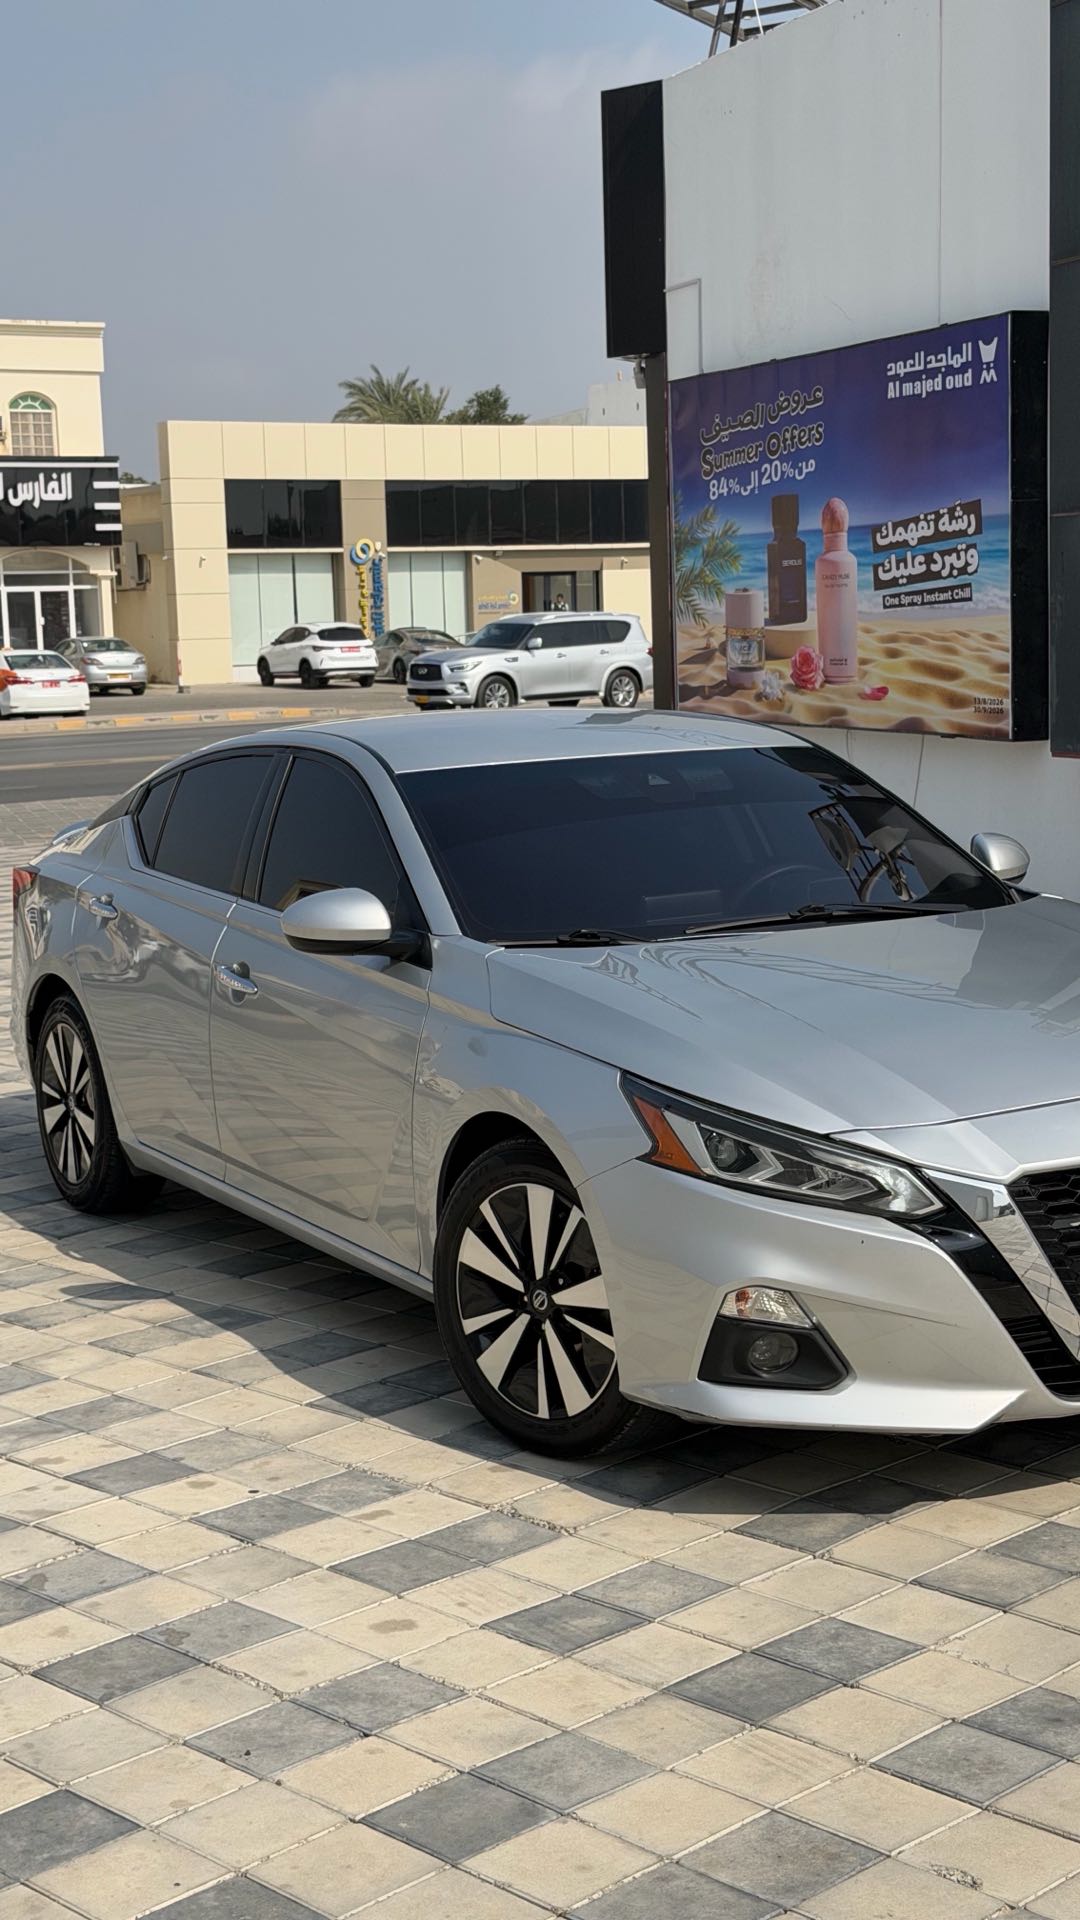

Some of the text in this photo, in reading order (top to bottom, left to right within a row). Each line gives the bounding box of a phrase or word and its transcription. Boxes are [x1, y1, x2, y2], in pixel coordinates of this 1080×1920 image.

[887, 341, 972, 377] الماجد للعود
[887, 368, 972, 399] Al majed oud
[700, 386, 824, 446] عروض الصيف
[701, 422, 824, 480] Summer Offers
[7, 472, 73, 509] الفارس
[876, 513, 935, 546] تفهمك
[878, 544, 979, 584] وتبرد عليك
[884, 587, 971, 607] One Spray Instant Chill
